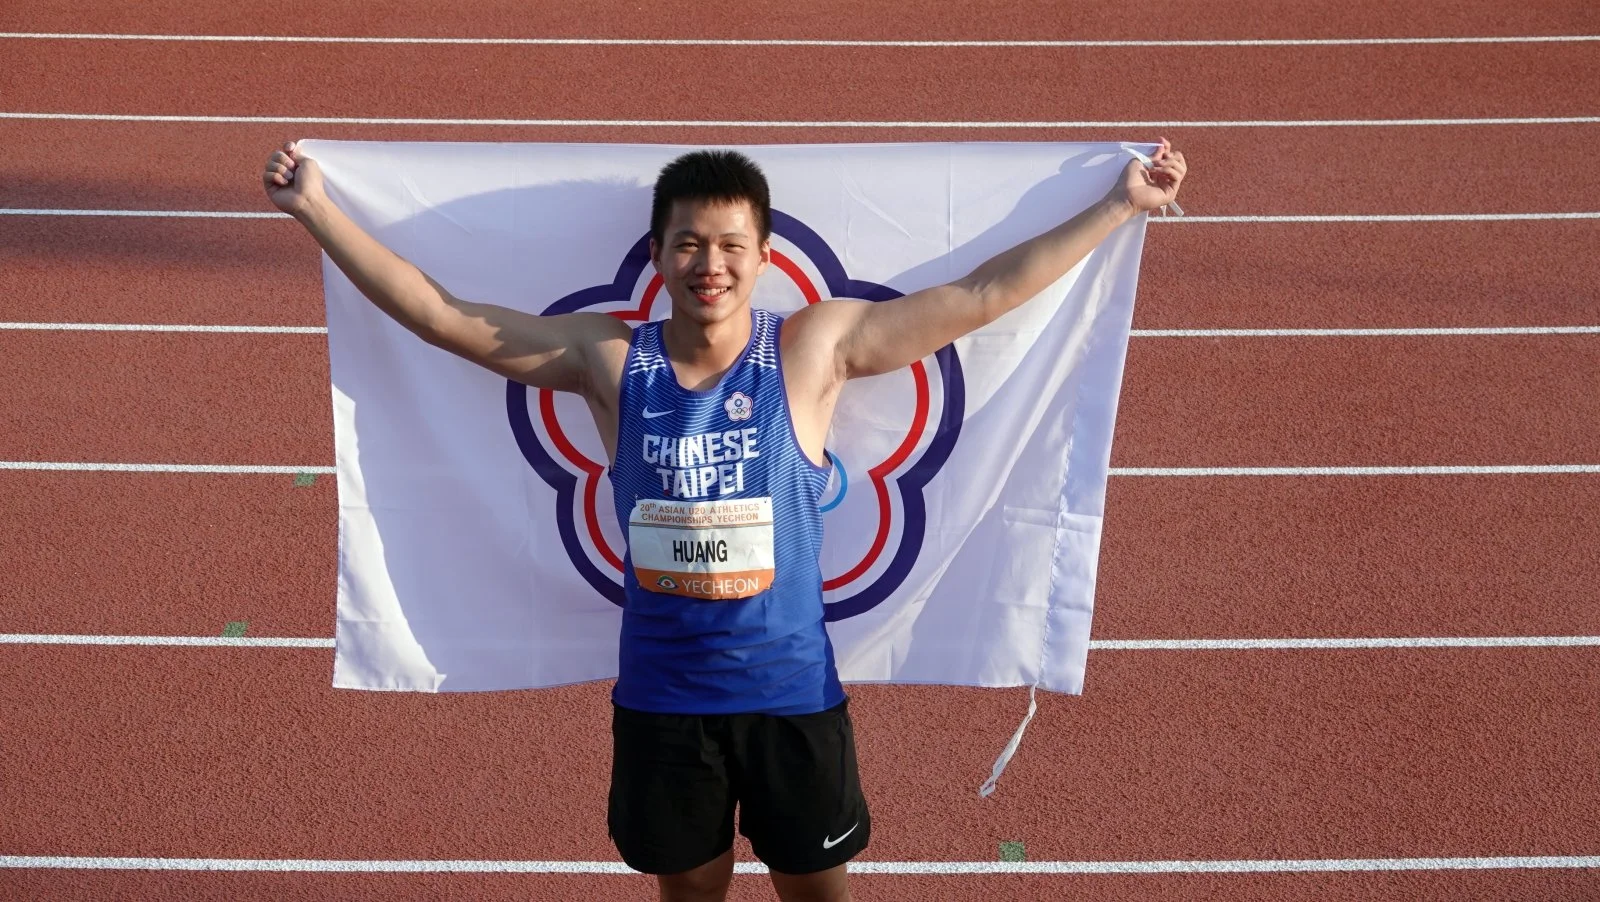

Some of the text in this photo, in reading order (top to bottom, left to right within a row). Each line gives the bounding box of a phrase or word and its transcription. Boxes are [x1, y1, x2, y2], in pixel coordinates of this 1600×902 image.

[642, 427, 760, 468] CHINESE
[656, 463, 745, 498] TAIPEI
[640, 503, 760, 515] 20th ASIAN U20 ATHLETICS
[641, 513, 759, 524] CHAMPIONSHIPS YECHEON
[672, 539, 728, 563] HUANG
[682, 578, 759, 595] YECHEON
